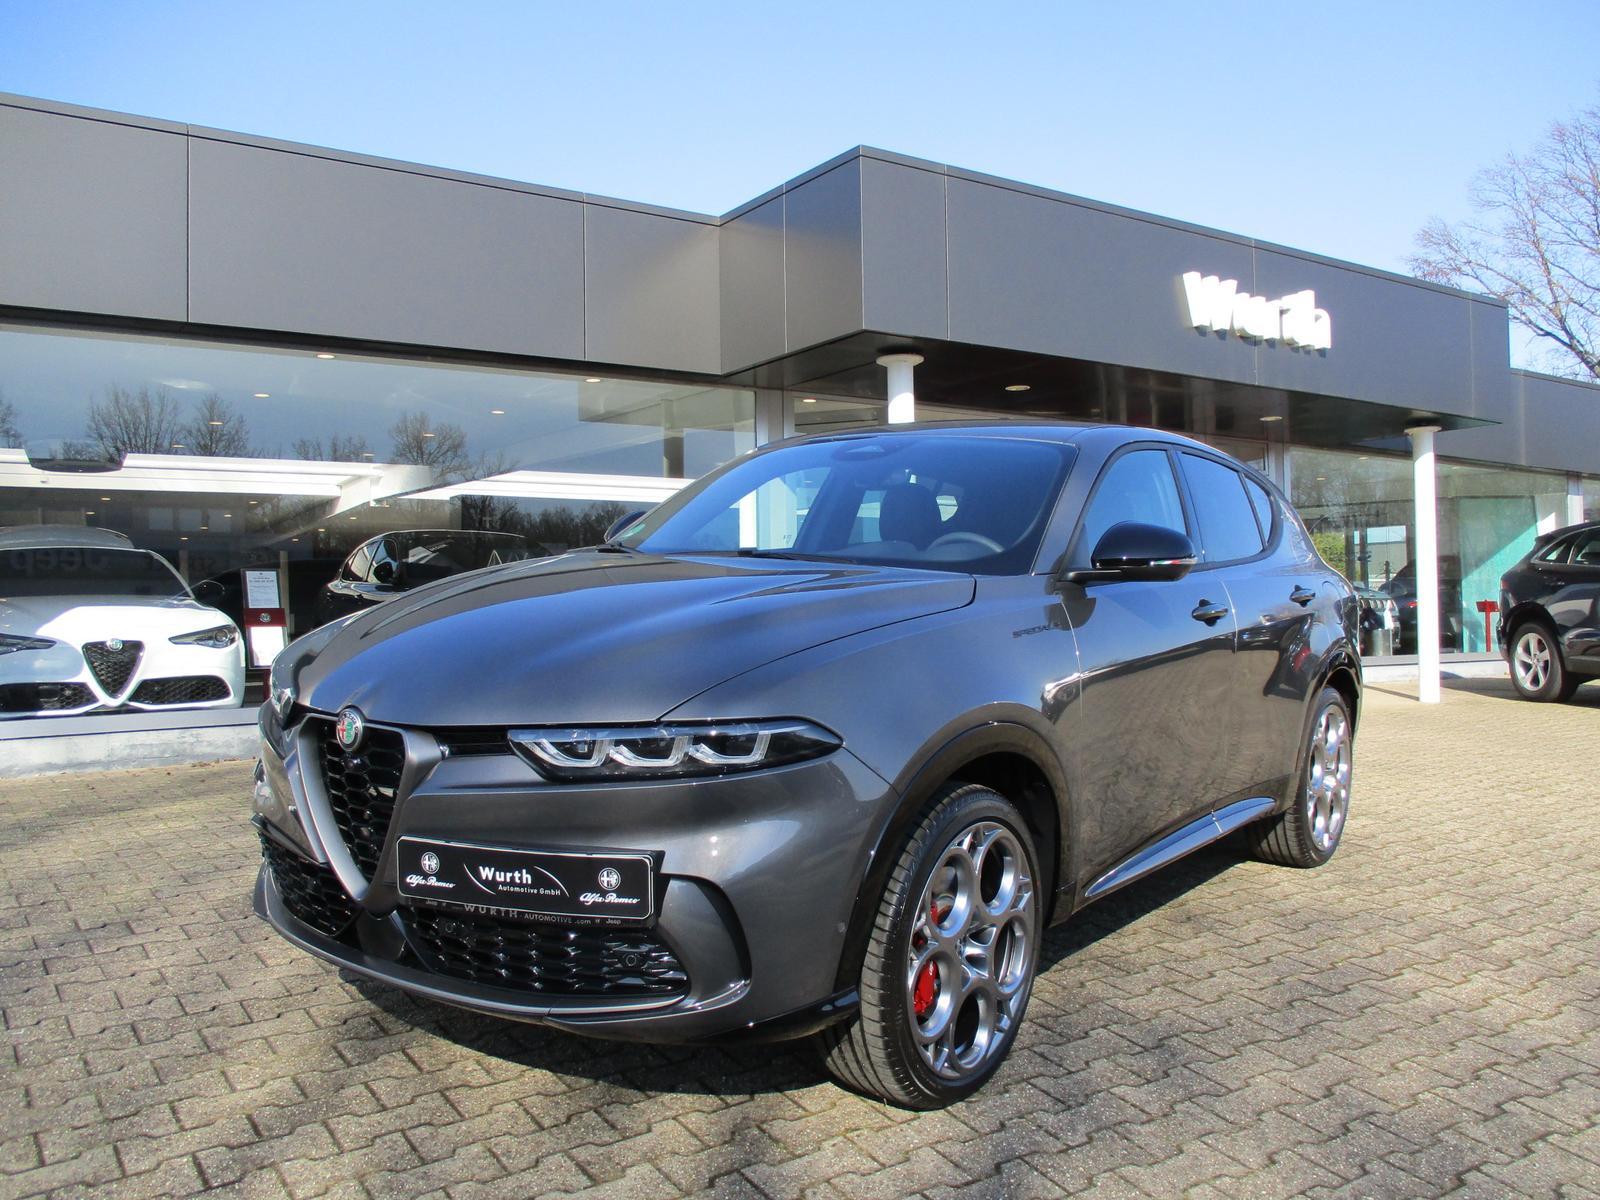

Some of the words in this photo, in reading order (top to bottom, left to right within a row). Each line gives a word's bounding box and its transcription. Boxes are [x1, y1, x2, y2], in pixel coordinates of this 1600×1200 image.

[1177, 271, 1332, 350] Wurth
[406, 874, 427, 887] Alfa
[427, 876, 456, 888] Romeo
[479, 866, 532, 884] Wurth
[498, 885, 538, 894] Automotive
[540, 888, 561, 896] GmbH
[579, 892, 604, 905] Alfa
[605, 893, 640, 904] Romeo
[464, 903, 518, 918] WURTH
[524, 913, 572, 924] AUTOMOTIVE
